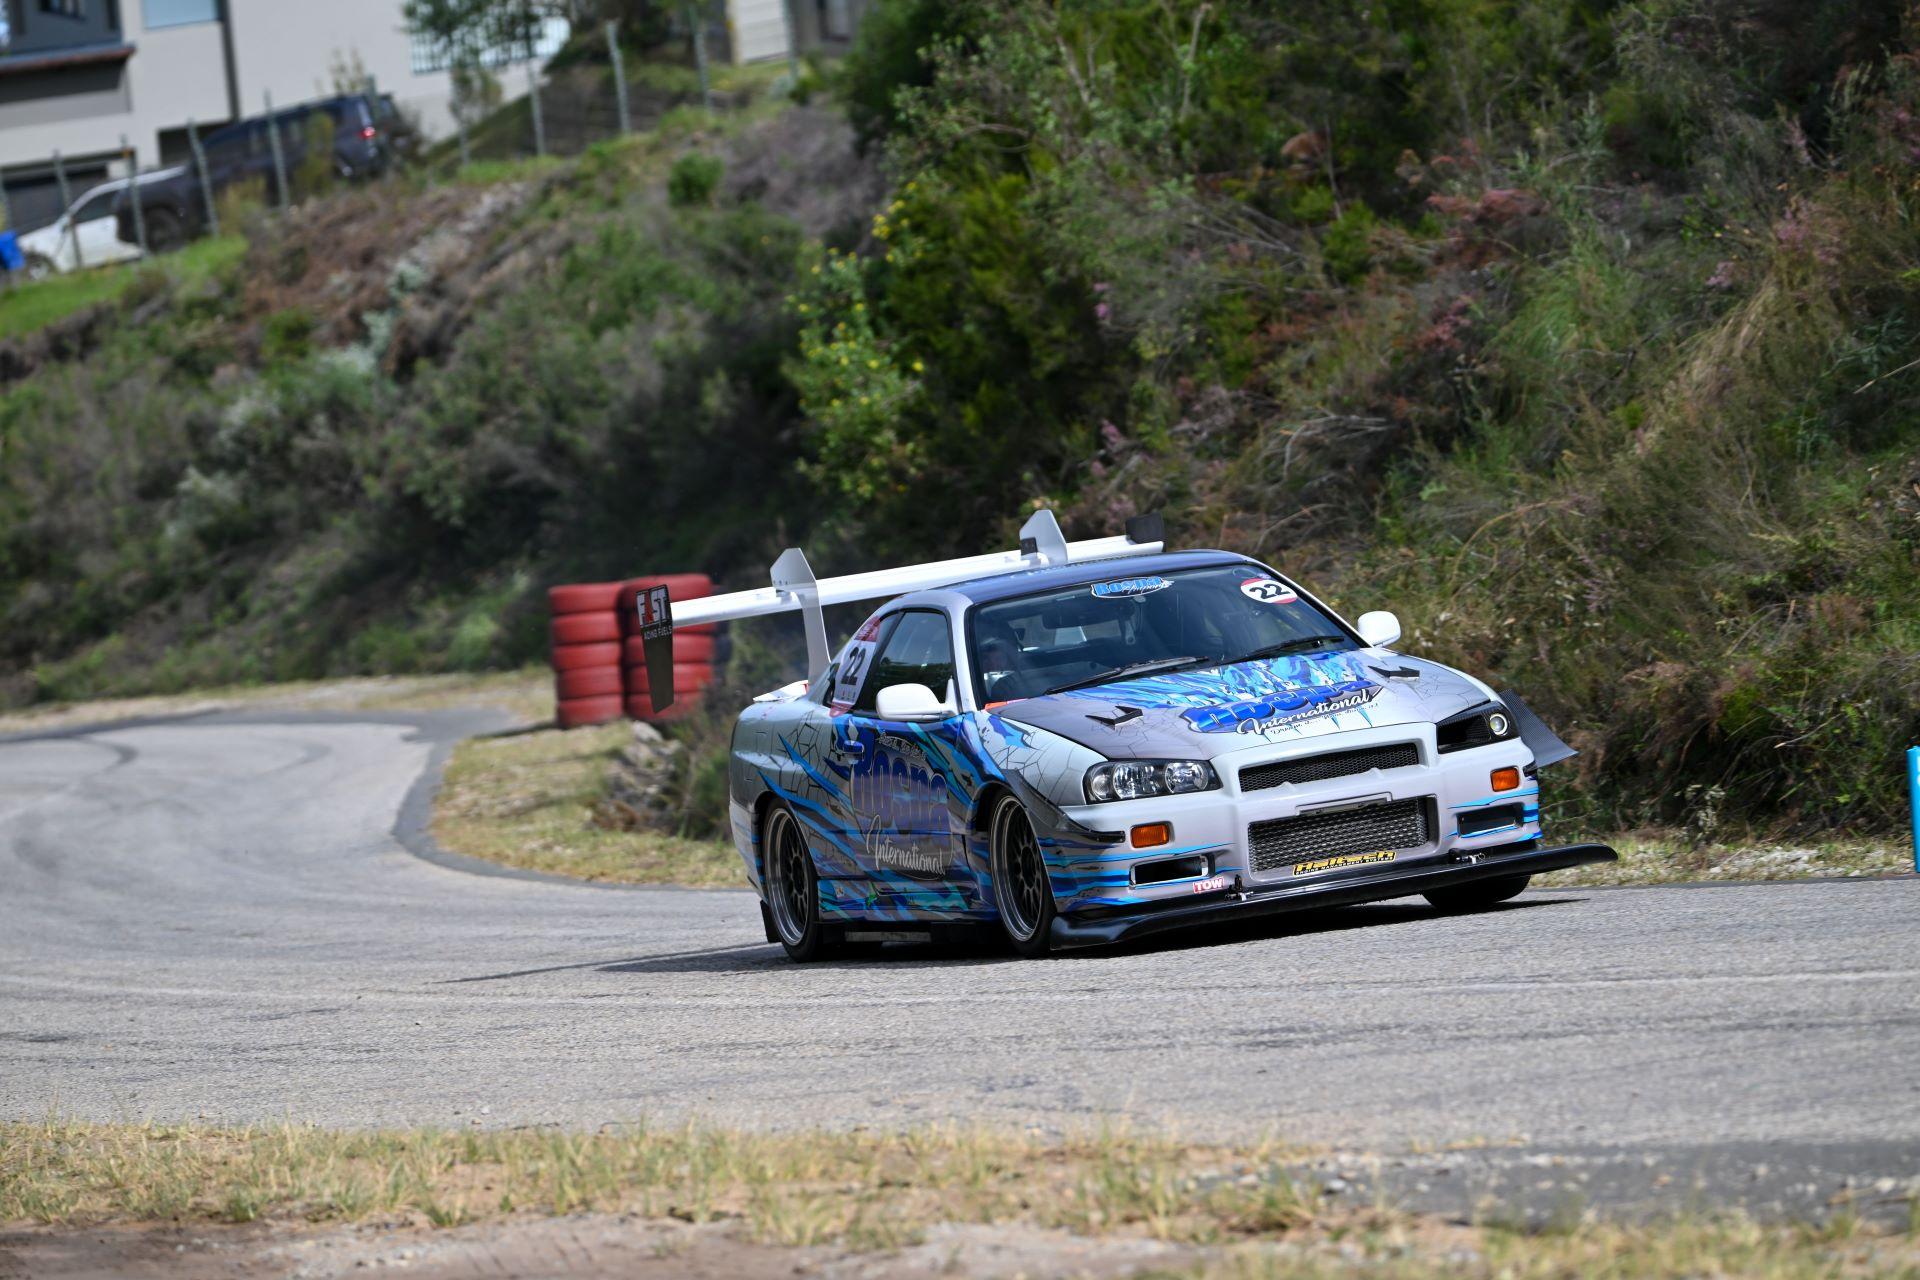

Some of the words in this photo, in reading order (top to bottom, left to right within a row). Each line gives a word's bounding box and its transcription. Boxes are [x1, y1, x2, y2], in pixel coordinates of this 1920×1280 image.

[637, 588, 668, 626] FAST
[1249, 584, 1290, 599] 22
[841, 647, 866, 686] 22
[1237, 689, 1370, 734] International
[867, 815, 945, 876] International
[1195, 879, 1222, 890] TOW
